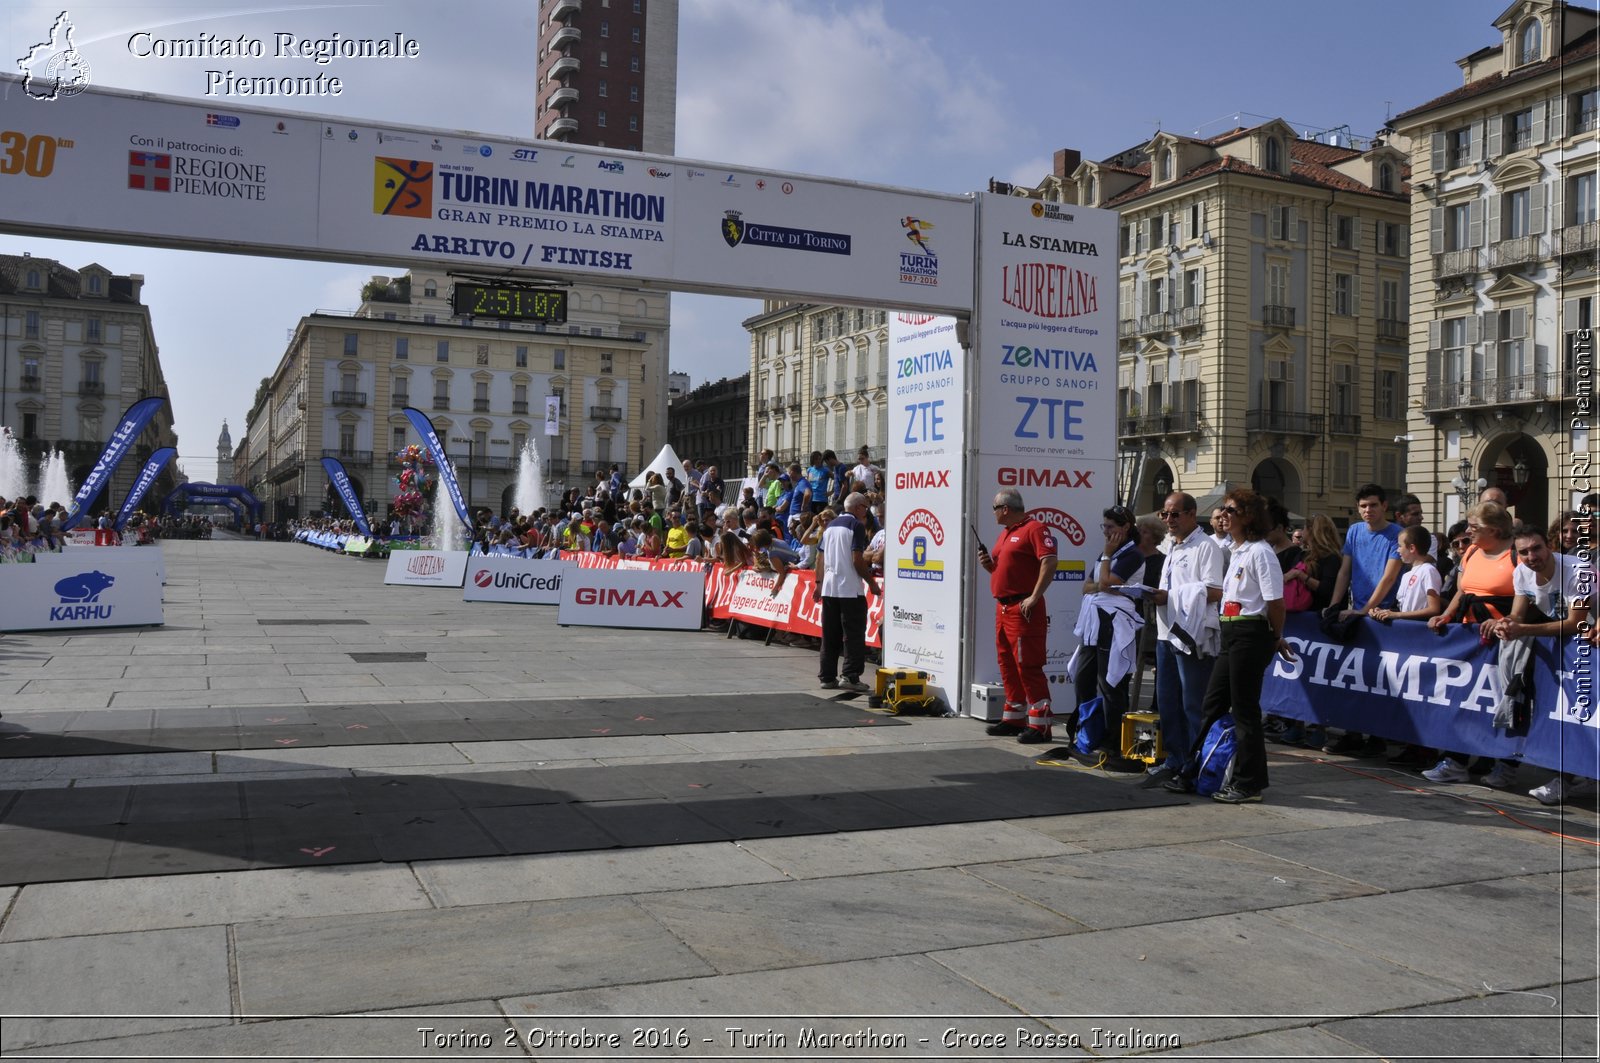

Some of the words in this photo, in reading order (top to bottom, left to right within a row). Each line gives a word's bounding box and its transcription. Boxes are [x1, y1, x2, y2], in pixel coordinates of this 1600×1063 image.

[0, 131, 57, 178] 30
[57, 137, 74, 149] km
[130, 134, 154, 147] Con
[158, 136, 165, 149] il
[167, 140, 226, 157] patrocinio
[229, 144, 244, 157] di:
[174, 157, 266, 183] REGIONE
[174, 177, 266, 201] PIEMONTE
[439, 172, 518, 207] TURIN
[525, 181, 665, 222] MARATHON
[1044, 203, 1060, 212] TEAM
[1044, 211, 1074, 222] MARATHON
[438, 208, 490, 224] GRAN
[497, 213, 567, 232] PREMIO
[573, 222, 595, 235] LA
[601, 225, 664, 242] STAMPA
[411, 234, 515, 259] ARRIVO
[521, 244, 533, 264] /
[541, 245, 632, 270] FINISH
[1002, 231, 1026, 248] LA
[1029, 235, 1099, 256] STAMPA
[900, 254, 938, 269] TURIN
[900, 266, 938, 276] MARATHON
[900, 274, 938, 285] 1987-2016
[1002, 263, 1098, 318] LAURETANA
[474, 287, 561, 318] 2:51:07
[1001, 319, 1027, 329] L'acqua
[1028, 322, 1040, 330] più
[1041, 323, 1066, 333] leggera
[1068, 325, 1098, 336] d'Europa
[897, 382, 924, 396] GRUPPO
[926, 376, 954, 390] SANOFI
[1000, 374, 1050, 386] GRUPPO
[1056, 379, 1098, 390] SANOFI
[904, 400, 944, 444] ZTE
[1014, 396, 1084, 441] ZTE
[1014, 445, 1046, 454] Tomorrow
[895, 469, 949, 490] GIMAX
[997, 467, 1093, 489] GIMAX
[899, 511, 943, 543] TAPPOROSSO
[407, 555, 445, 575] LAURETANA
[494, 572, 562, 590] UniCredi
[1065, 572, 1083, 580] Torino
[575, 587, 684, 608] GIMAX
[50, 605, 112, 621] KARHU
[893, 606, 922, 622] Tailorsan
[1273, 636, 1502, 714] STAMPA
